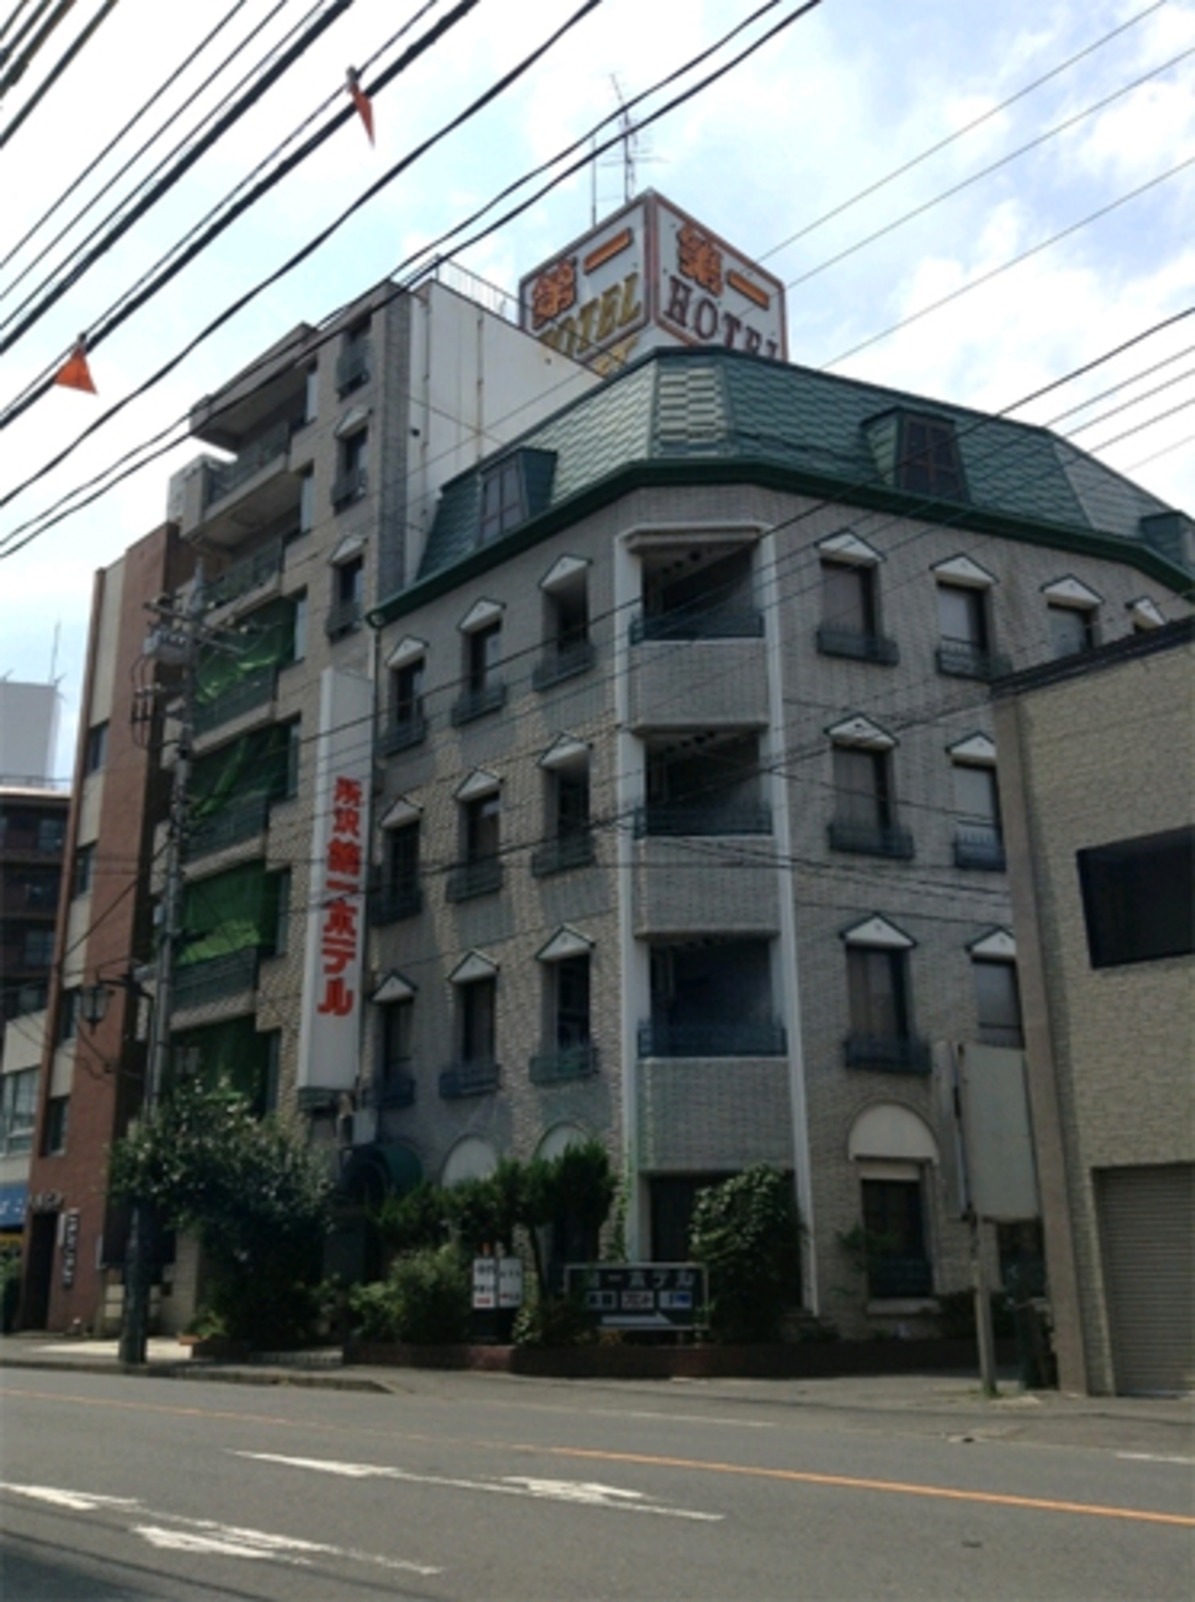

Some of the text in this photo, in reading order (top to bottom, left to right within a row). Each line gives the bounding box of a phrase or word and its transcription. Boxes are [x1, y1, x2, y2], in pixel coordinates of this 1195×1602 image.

[532, 226, 635, 331] 第一
[676, 222, 772, 312] 第一
[318, 777, 363, 1016] 所沢第一ホテル
